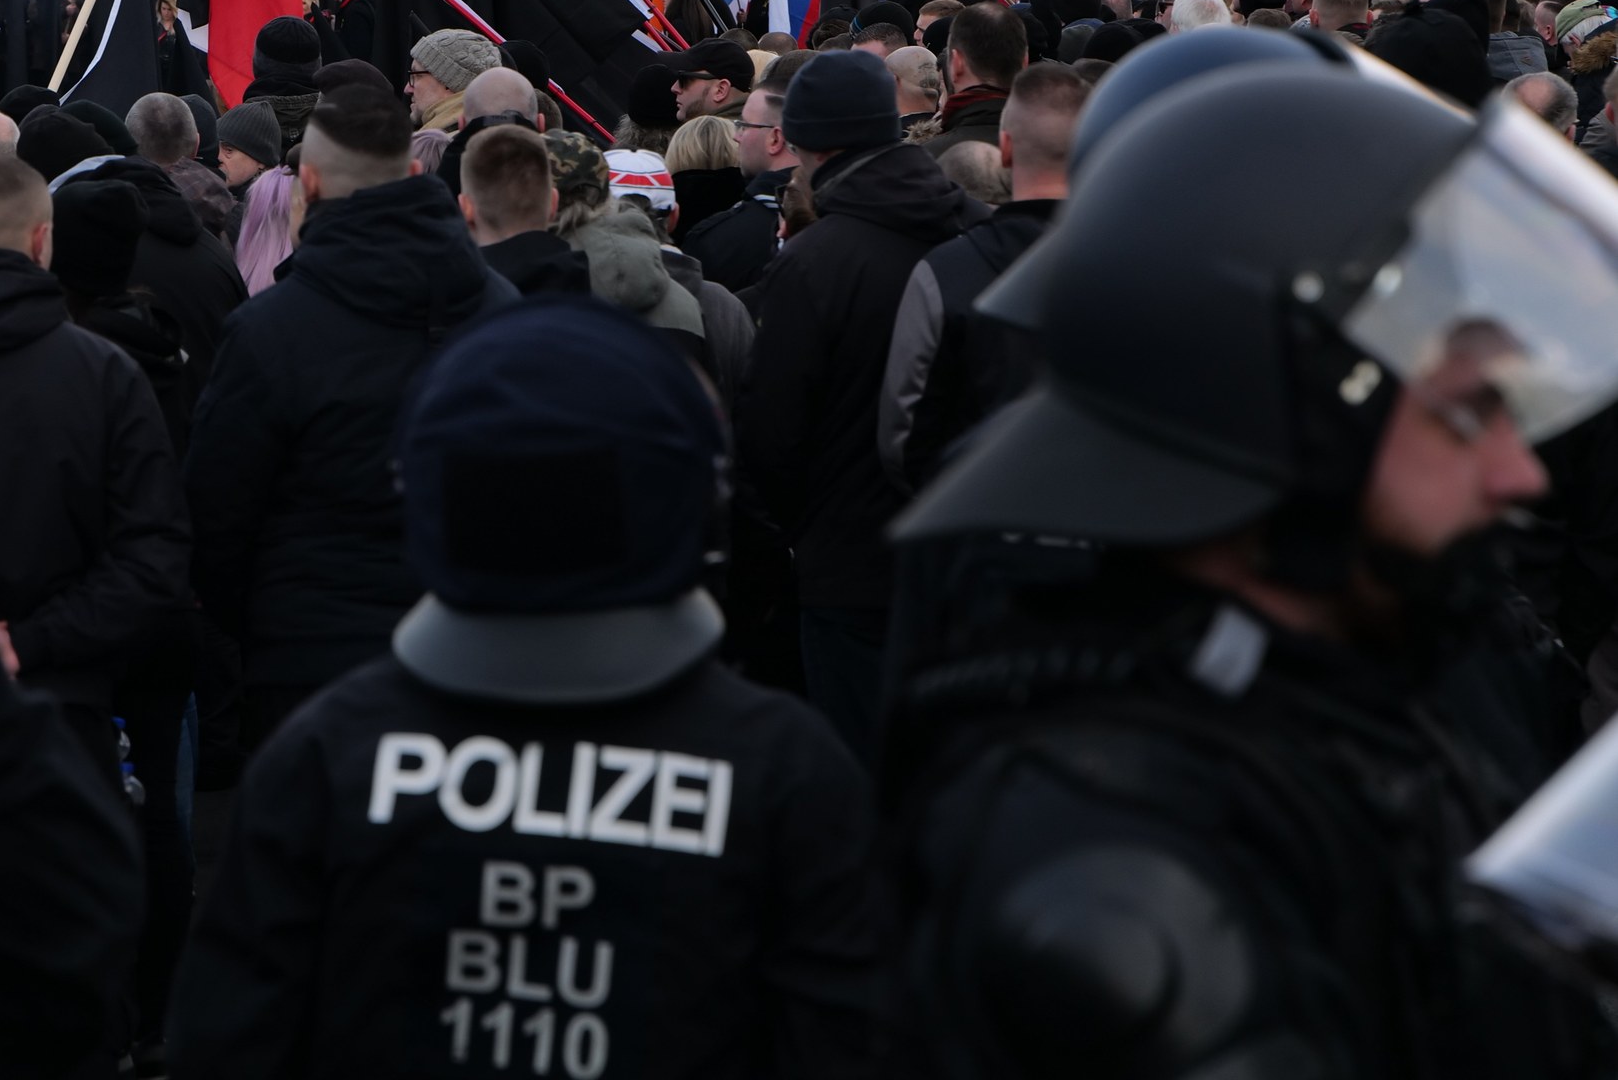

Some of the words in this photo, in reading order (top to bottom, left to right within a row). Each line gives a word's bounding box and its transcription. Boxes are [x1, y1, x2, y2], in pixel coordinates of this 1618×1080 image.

[367, 730, 734, 859] POLIZEI
[479, 860, 597, 930] BP
[445, 930, 615, 1010] BLU
[439, 998, 611, 1080] 1110
